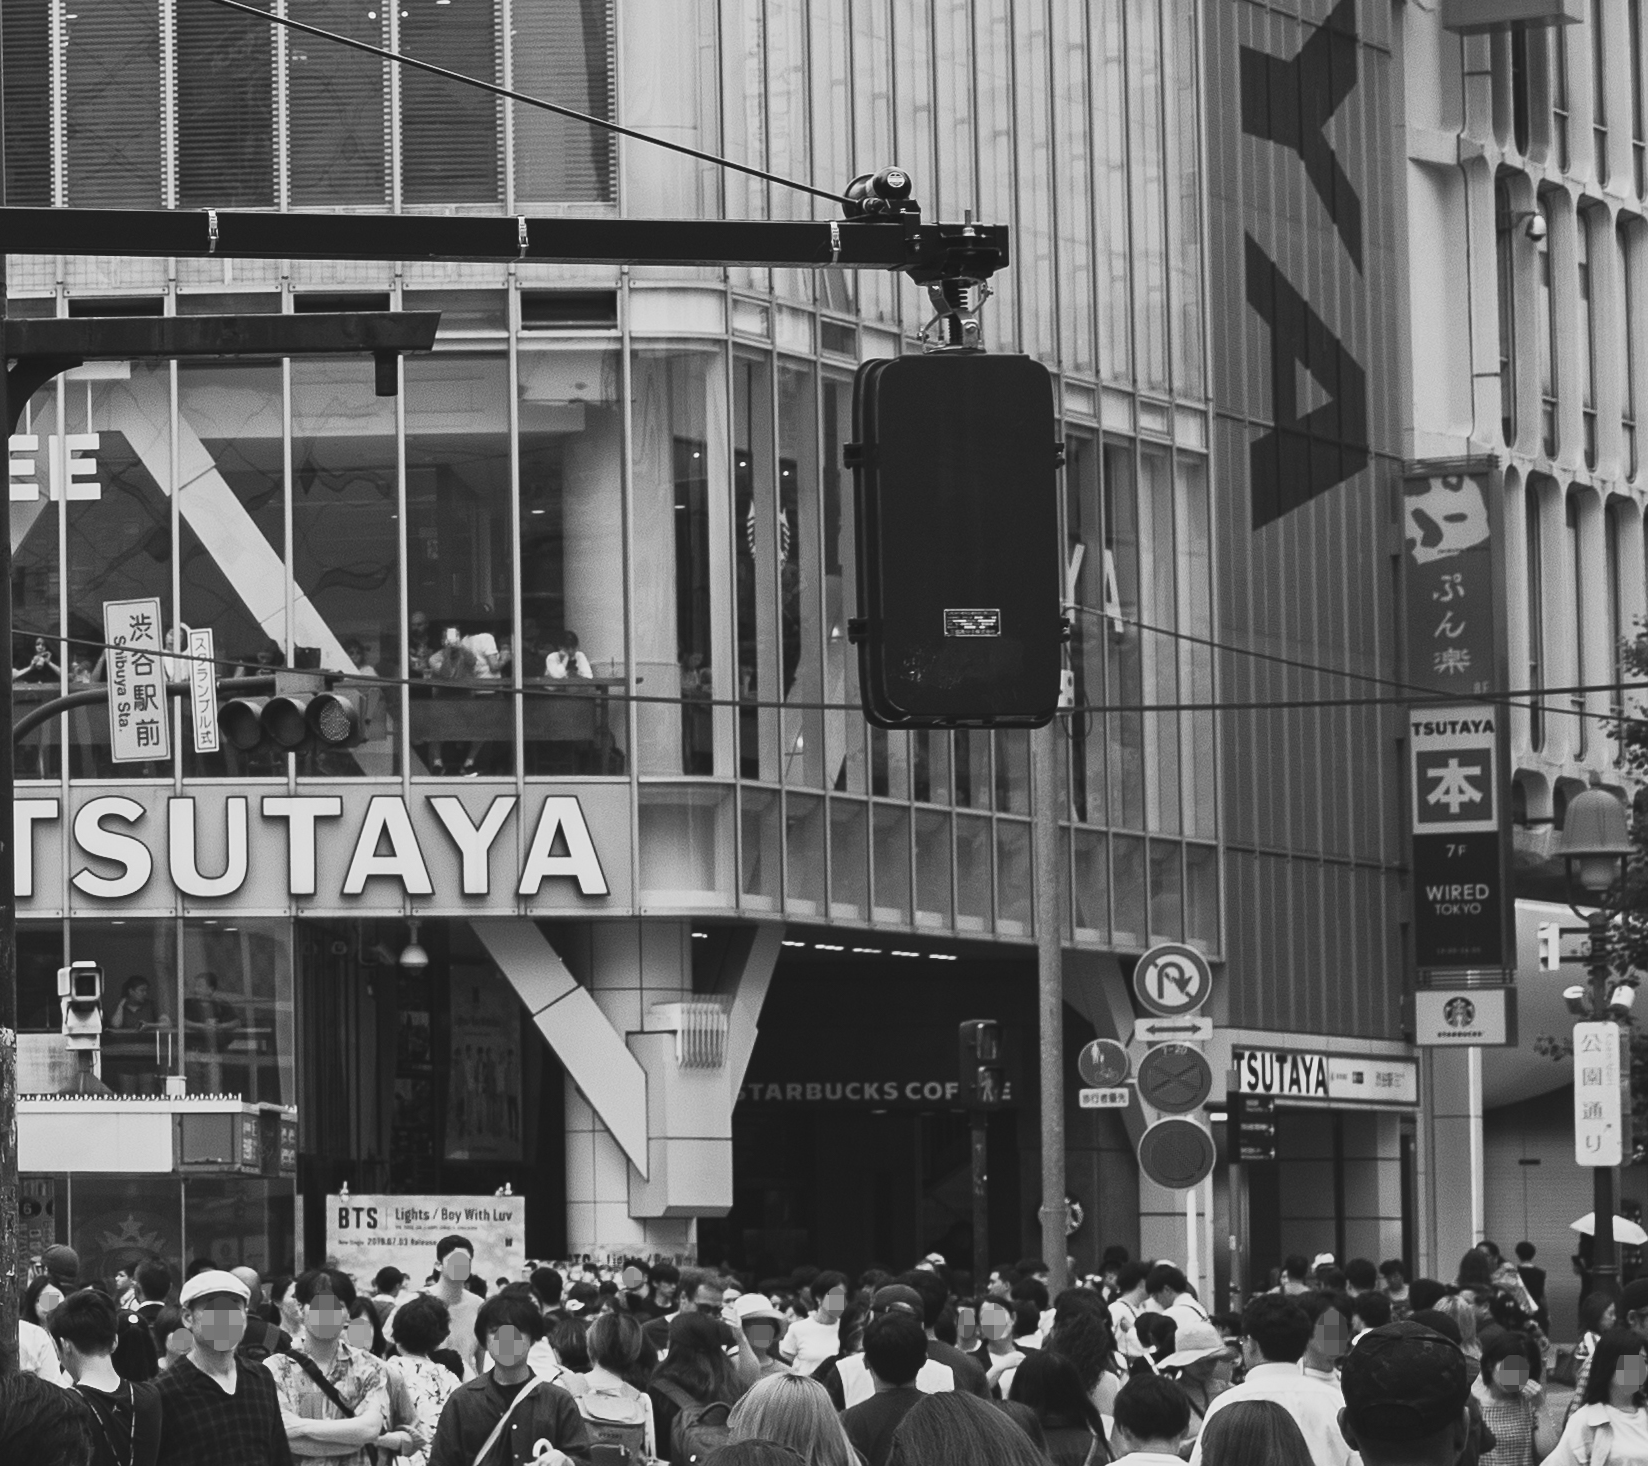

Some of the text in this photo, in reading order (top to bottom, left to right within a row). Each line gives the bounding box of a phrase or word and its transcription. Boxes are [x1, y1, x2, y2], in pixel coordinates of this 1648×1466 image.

[113, 636, 131, 733] Shibuya Sta.
[130, 613, 159, 748] 渋谷駅前
[1412, 719, 1495, 737] TSUTAYA
[1425, 758, 1484, 815] 本
[14, 795, 609, 897] TSUTAYA
[1446, 843, 1467, 859] 7F
[1425, 884, 1490, 903] WIRED
[1434, 903, 1482, 916] TOKYO
[1232, 1051, 1329, 1096] TSUTAYA
[1581, 1033, 1603, 1153] 公園通り
[338, 1207, 378, 1229] BTS
[395, 1207, 431, 1223] Lights
[441, 1208, 461, 1223] Boy
[464, 1208, 490, 1221] With
[492, 1210, 513, 1222] Luv
